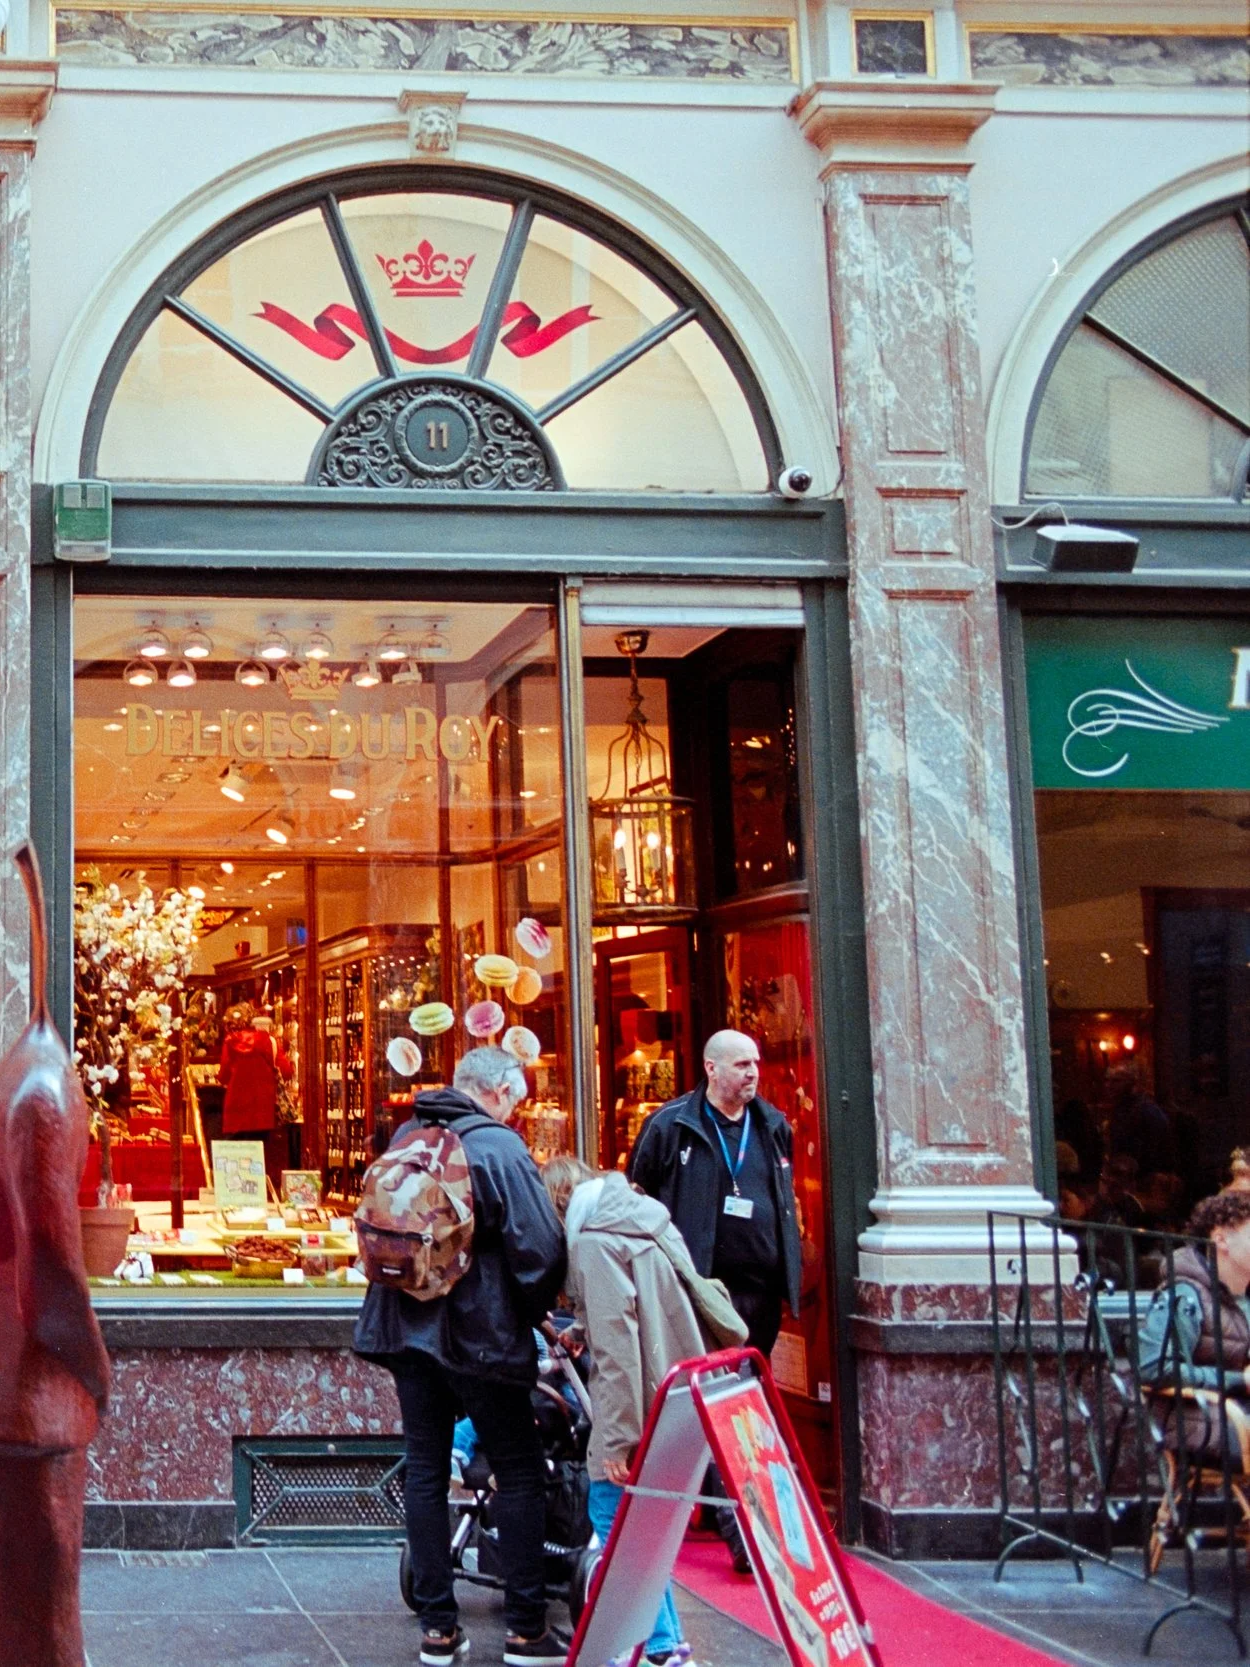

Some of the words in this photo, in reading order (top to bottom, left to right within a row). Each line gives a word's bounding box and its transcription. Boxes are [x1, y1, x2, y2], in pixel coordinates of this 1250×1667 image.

[426, 421, 448, 449] 11
[125, 702, 314, 760] DELICES
[329, 711, 392, 761] DU
[404, 706, 501, 763] ROY
